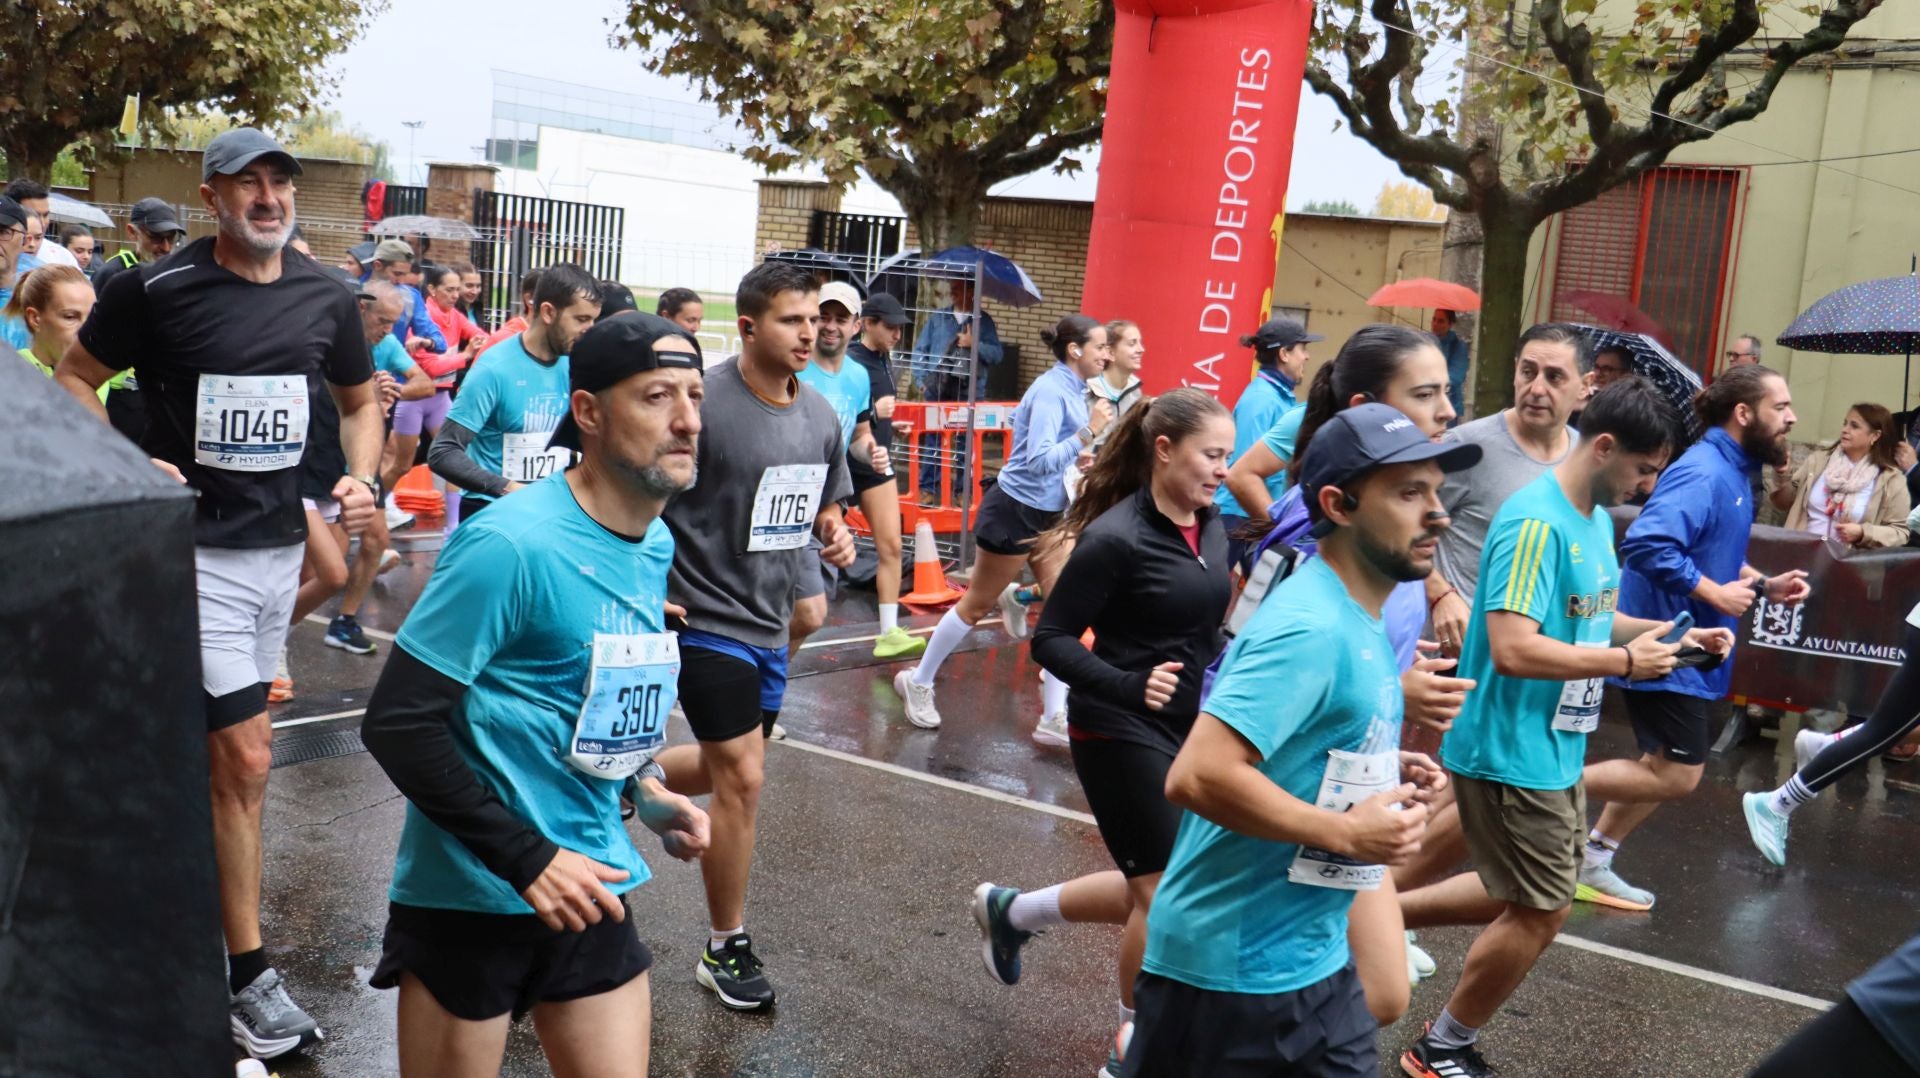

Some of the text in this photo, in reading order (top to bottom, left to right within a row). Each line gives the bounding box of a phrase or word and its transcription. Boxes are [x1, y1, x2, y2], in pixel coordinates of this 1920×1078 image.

[1181, 48, 1271, 397] ÍA DE DEPORTES
[220, 409, 289, 443] 1046
[239, 455, 288, 464] HYUNDAI
[522, 455, 556, 480] 1127
[769, 493, 808, 525] 1176
[611, 684, 662, 738] 390
